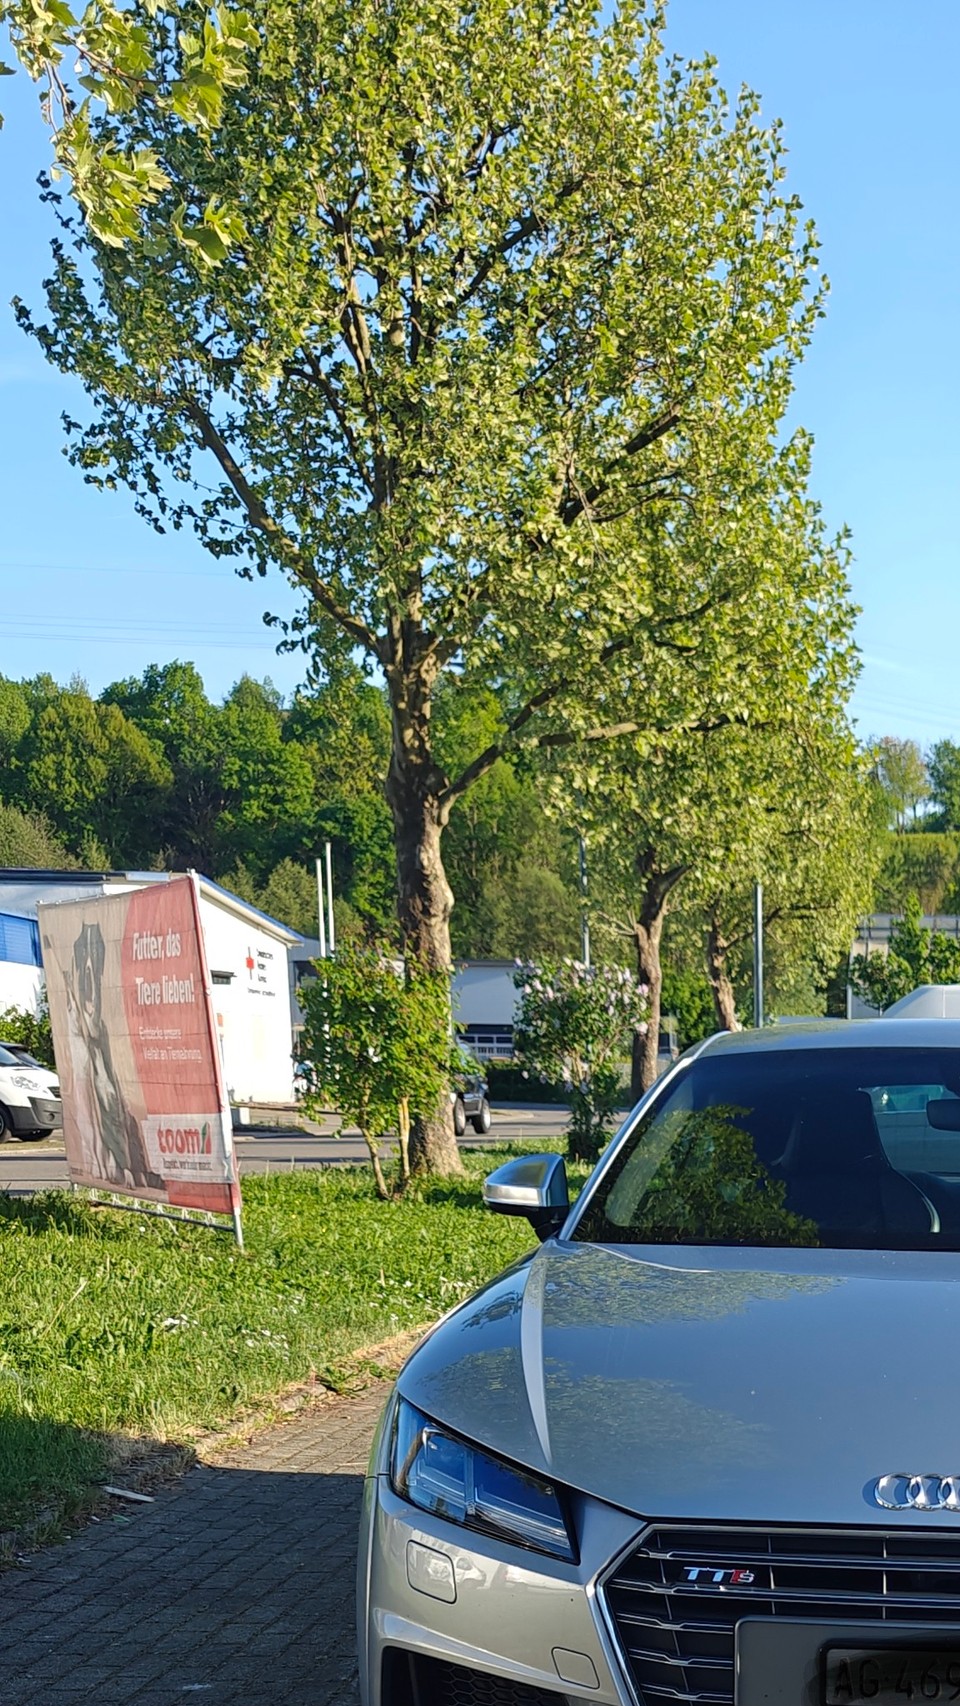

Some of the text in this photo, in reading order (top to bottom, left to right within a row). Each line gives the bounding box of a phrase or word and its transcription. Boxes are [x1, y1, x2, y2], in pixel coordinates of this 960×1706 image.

[132, 927, 182, 965] Futter, das
[135, 972, 196, 1005] Tiere lieben!
[157, 1123, 200, 1154] toom
[683, 1566, 755, 1584] TTS
